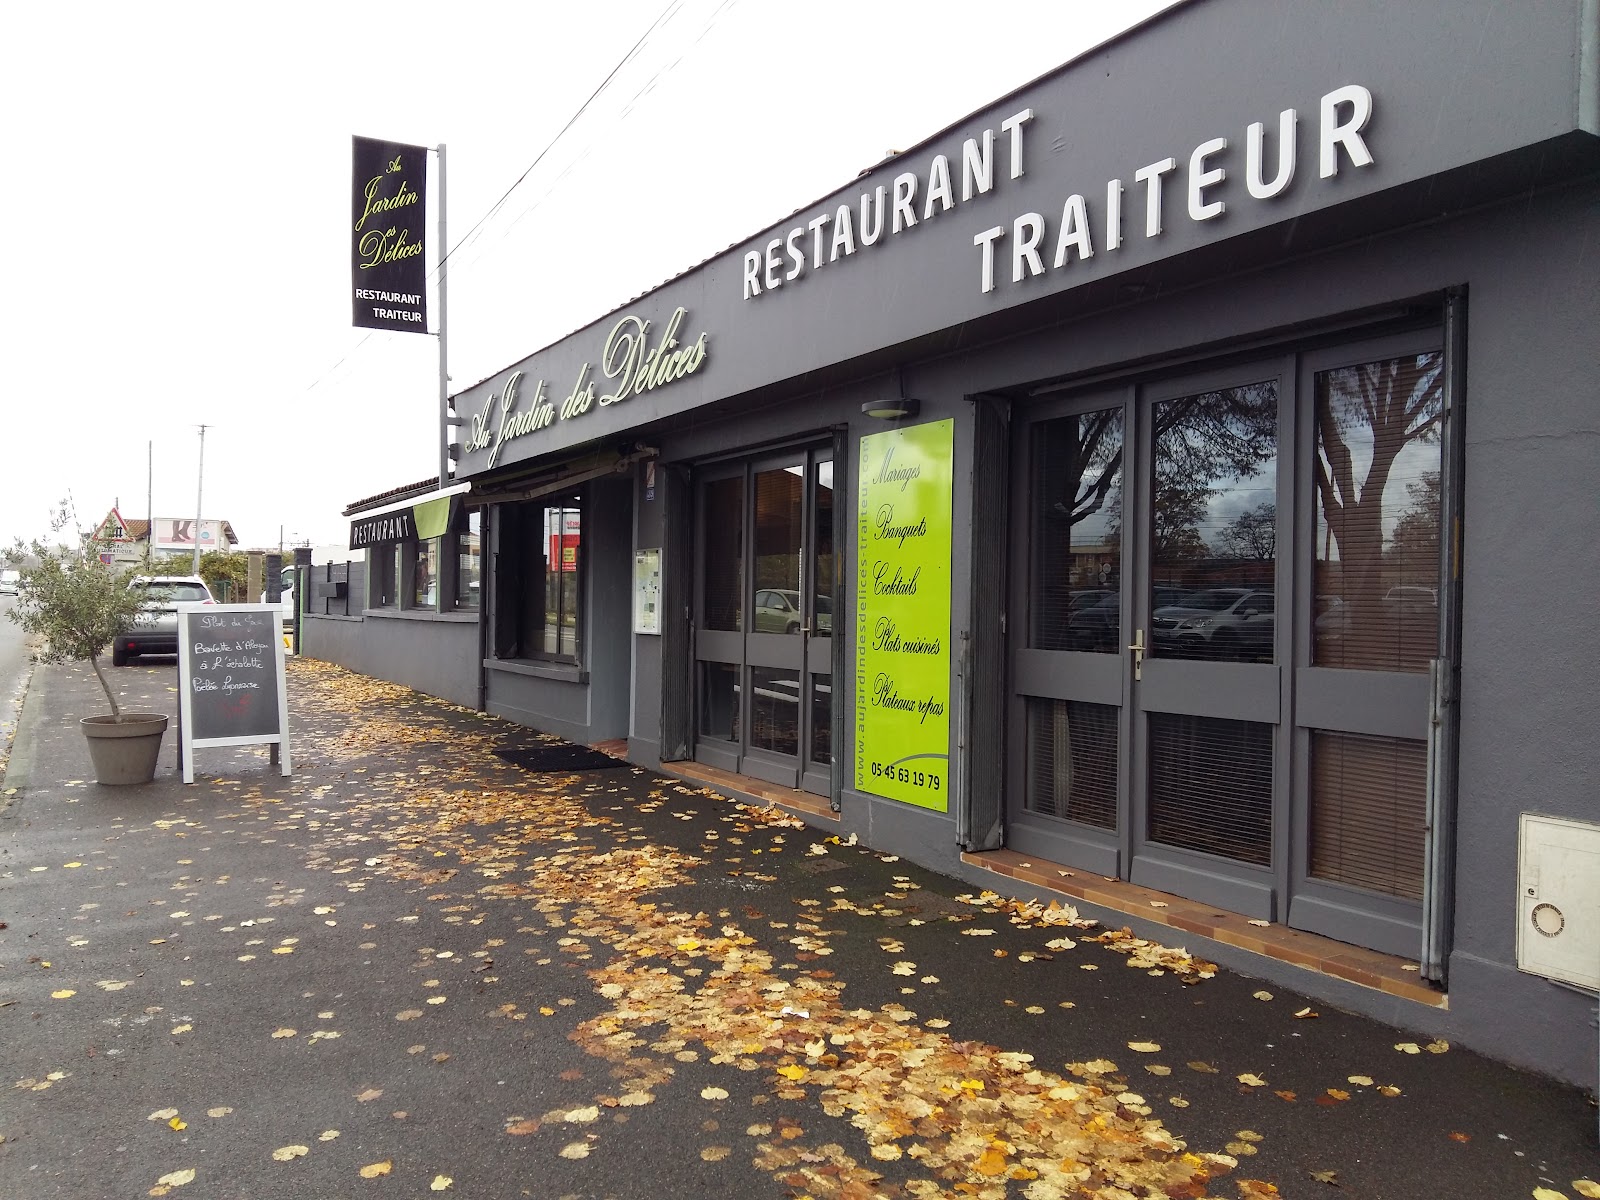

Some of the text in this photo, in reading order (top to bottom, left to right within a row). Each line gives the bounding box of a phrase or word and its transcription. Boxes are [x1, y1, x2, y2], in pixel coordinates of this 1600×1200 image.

[385, 155, 402, 174] Au
[354, 175, 419, 232] Jardin
[743, 107, 1035, 301] RESTAURANT
[972, 84, 1376, 294] TRAITEUR
[358, 228, 423, 269] Délices
[355, 288, 422, 305] RESTAURANT
[372, 307, 423, 323] TRAITEUR
[464, 306, 708, 469] Au Jardin des Délices
[872, 446, 922, 493] Mariages
[353, 515, 410, 545] RESTAURANT
[873, 503, 927, 550] Banquets
[872, 560, 922, 597] Cocktails
[200, 615, 228, 629] Plat
[231, 617, 243, 627] du
[871, 616, 941, 656] Plats cuisinés
[194, 641, 233, 655] Bavette
[871, 672, 945, 725] Plateaux repas
[871, 761, 941, 791] 05 45 63 19 79
